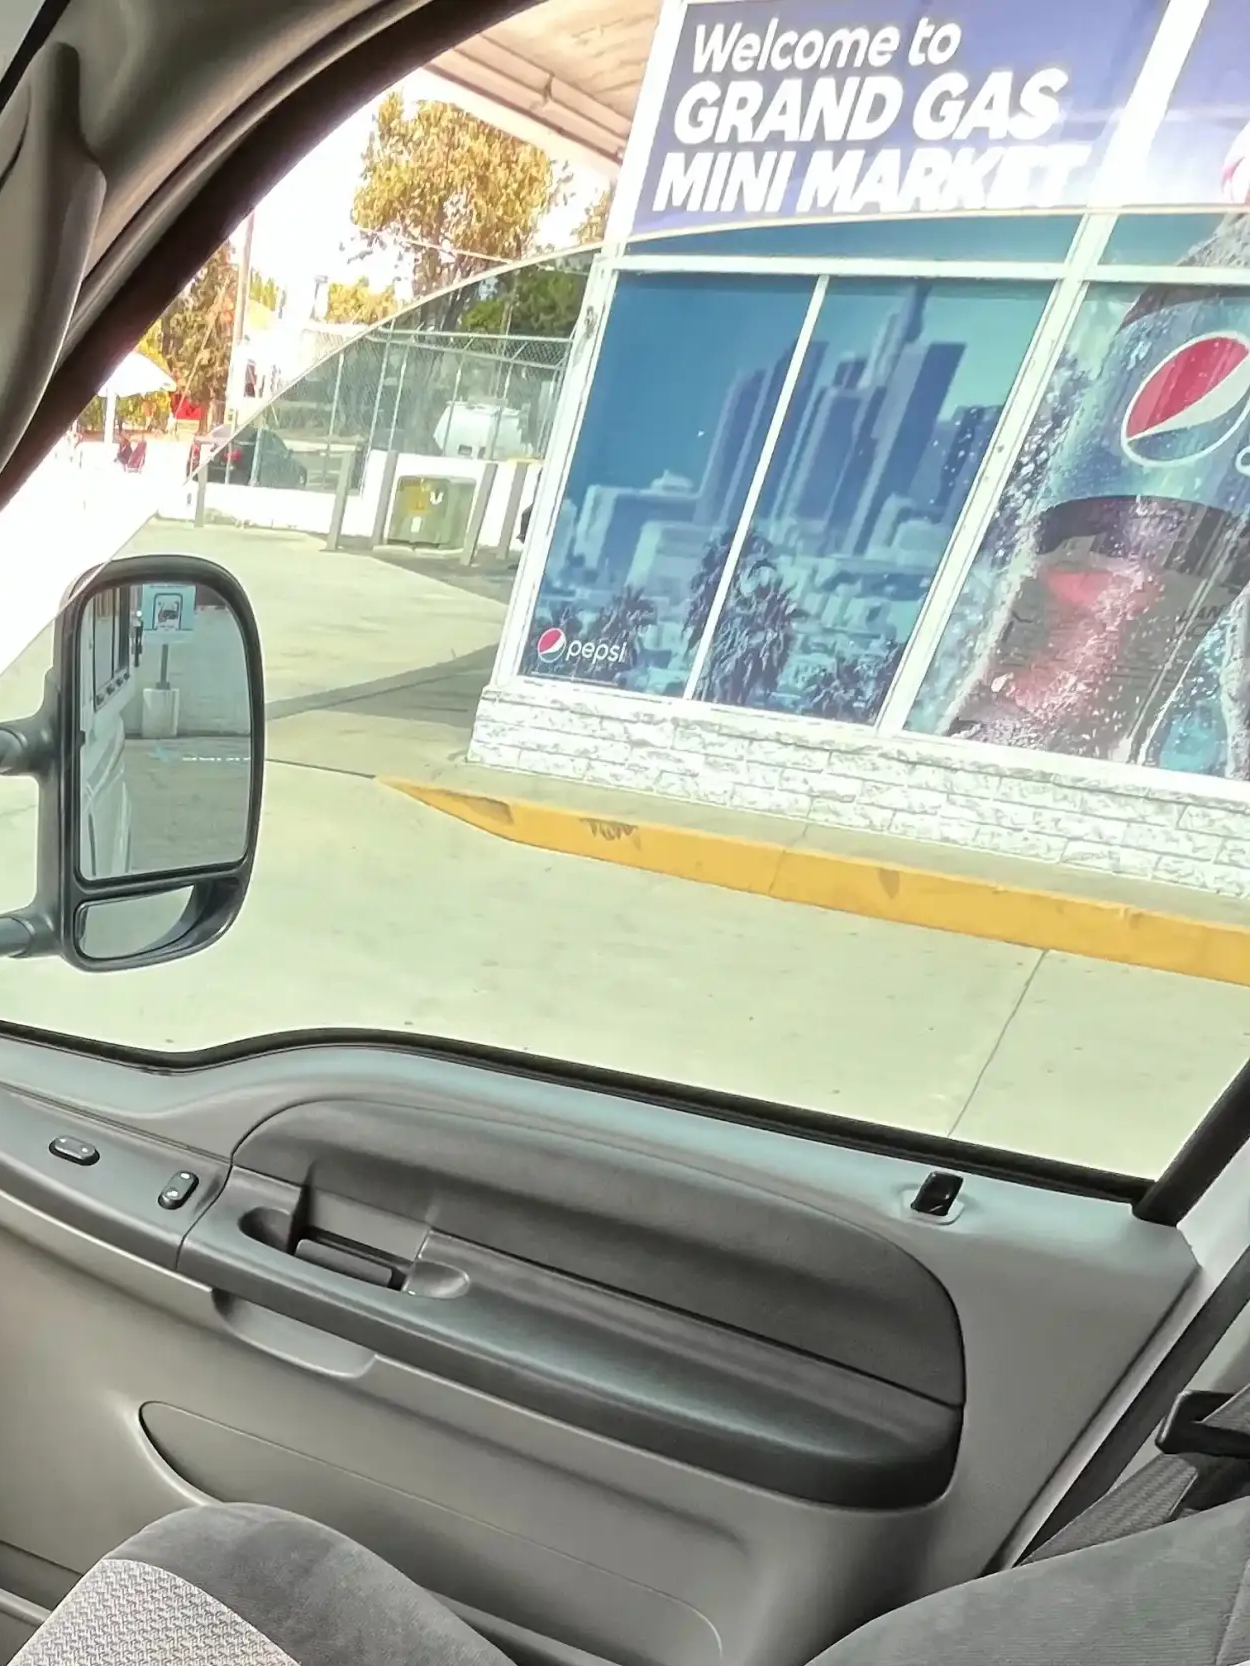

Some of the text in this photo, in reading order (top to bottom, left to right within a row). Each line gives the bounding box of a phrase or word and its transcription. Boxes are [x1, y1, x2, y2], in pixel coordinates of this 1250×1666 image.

[692, 16, 962, 74] Welcome to
[673, 67, 1069, 146] GRAND GAS
[652, 143, 1093, 214] MINI MARKET
[566, 640, 628, 665] pepsi
